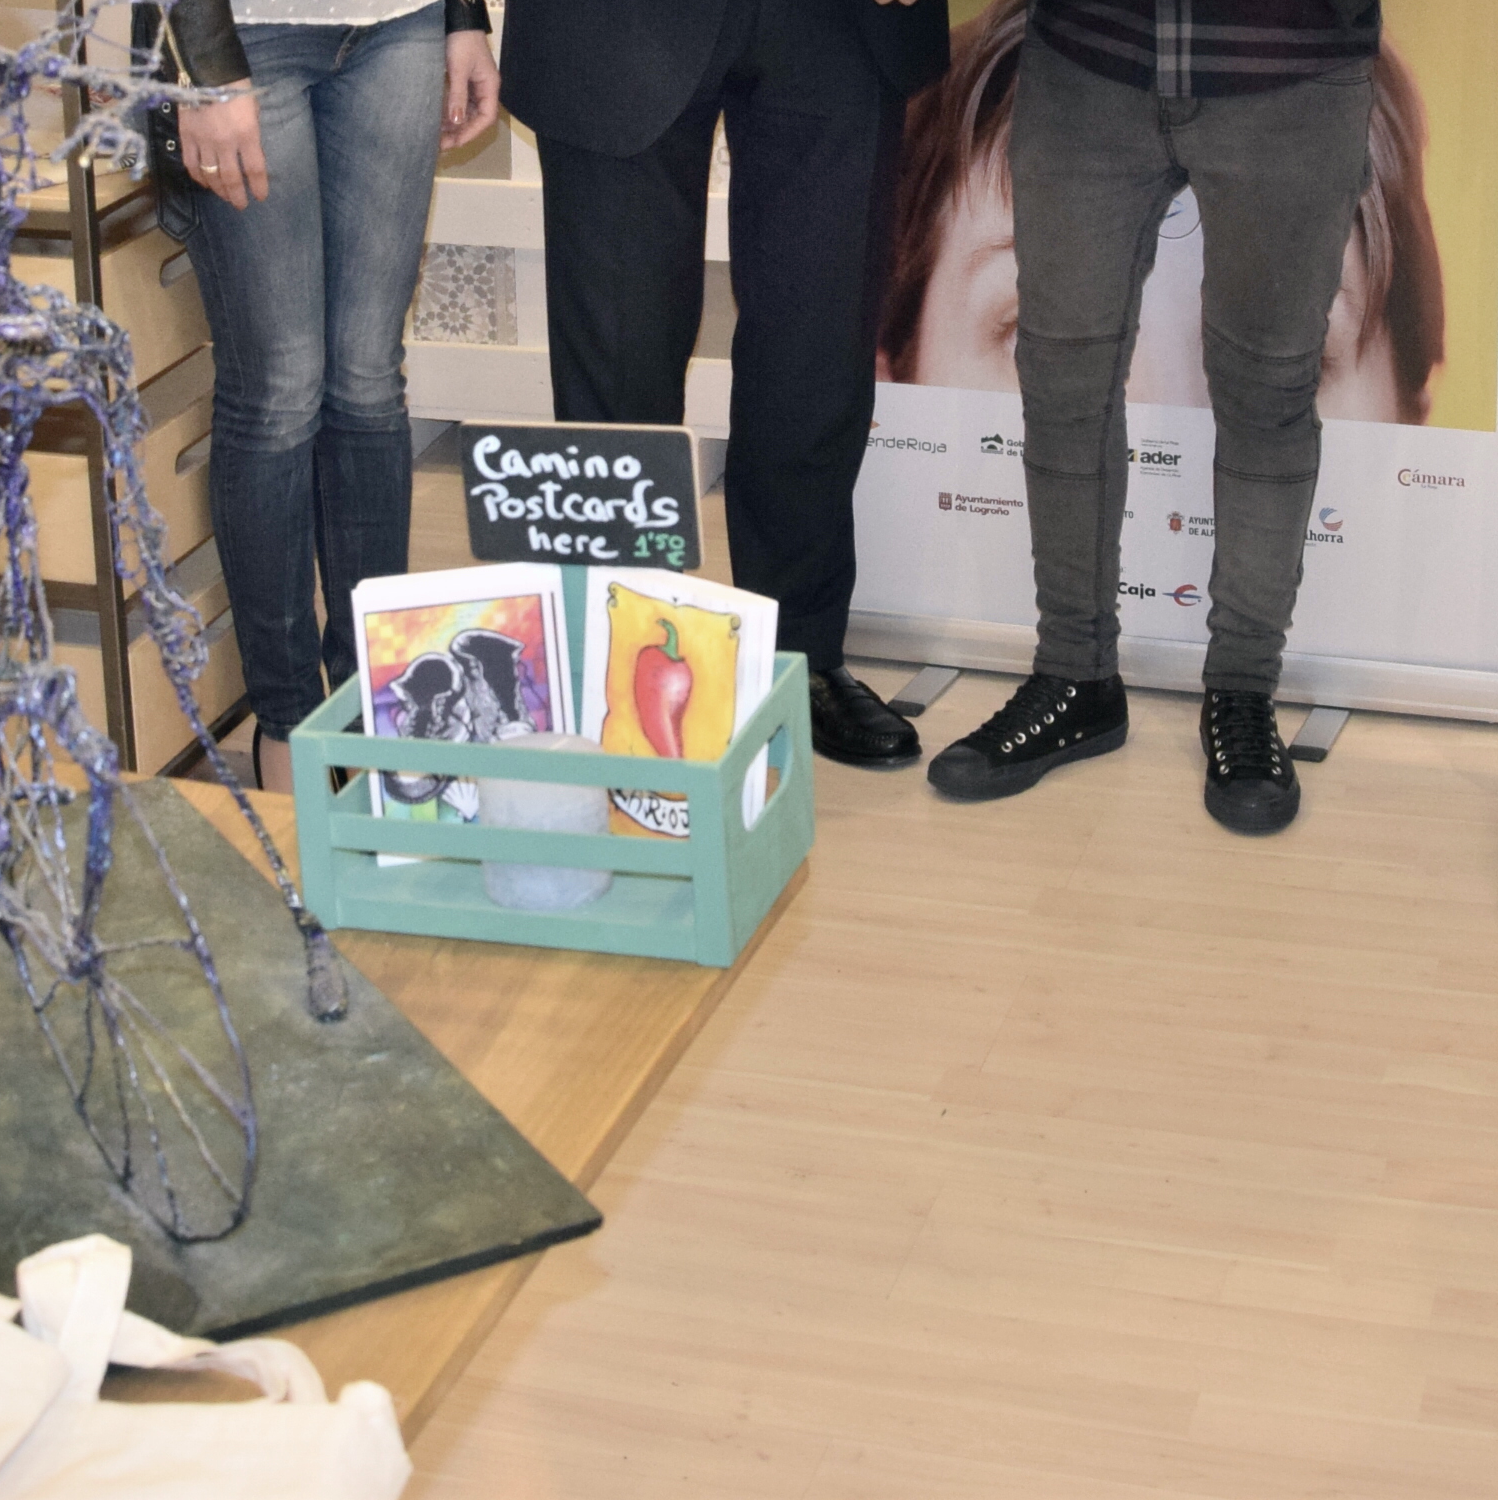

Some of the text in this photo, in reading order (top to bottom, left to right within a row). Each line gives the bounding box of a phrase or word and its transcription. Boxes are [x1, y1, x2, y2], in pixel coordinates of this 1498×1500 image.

[472, 434, 642, 481] Camino
[1006, 448, 1018, 457] de
[1140, 450, 1182, 466] ader
[1397, 467, 1466, 488] Cámara
[470, 479, 680, 529] Postcards
[954, 493, 1024, 508] Ayuntamiento
[954, 503, 1010, 516] de Logroño
[1188, 527, 1200, 536] DE
[527, 525, 619, 559] here
